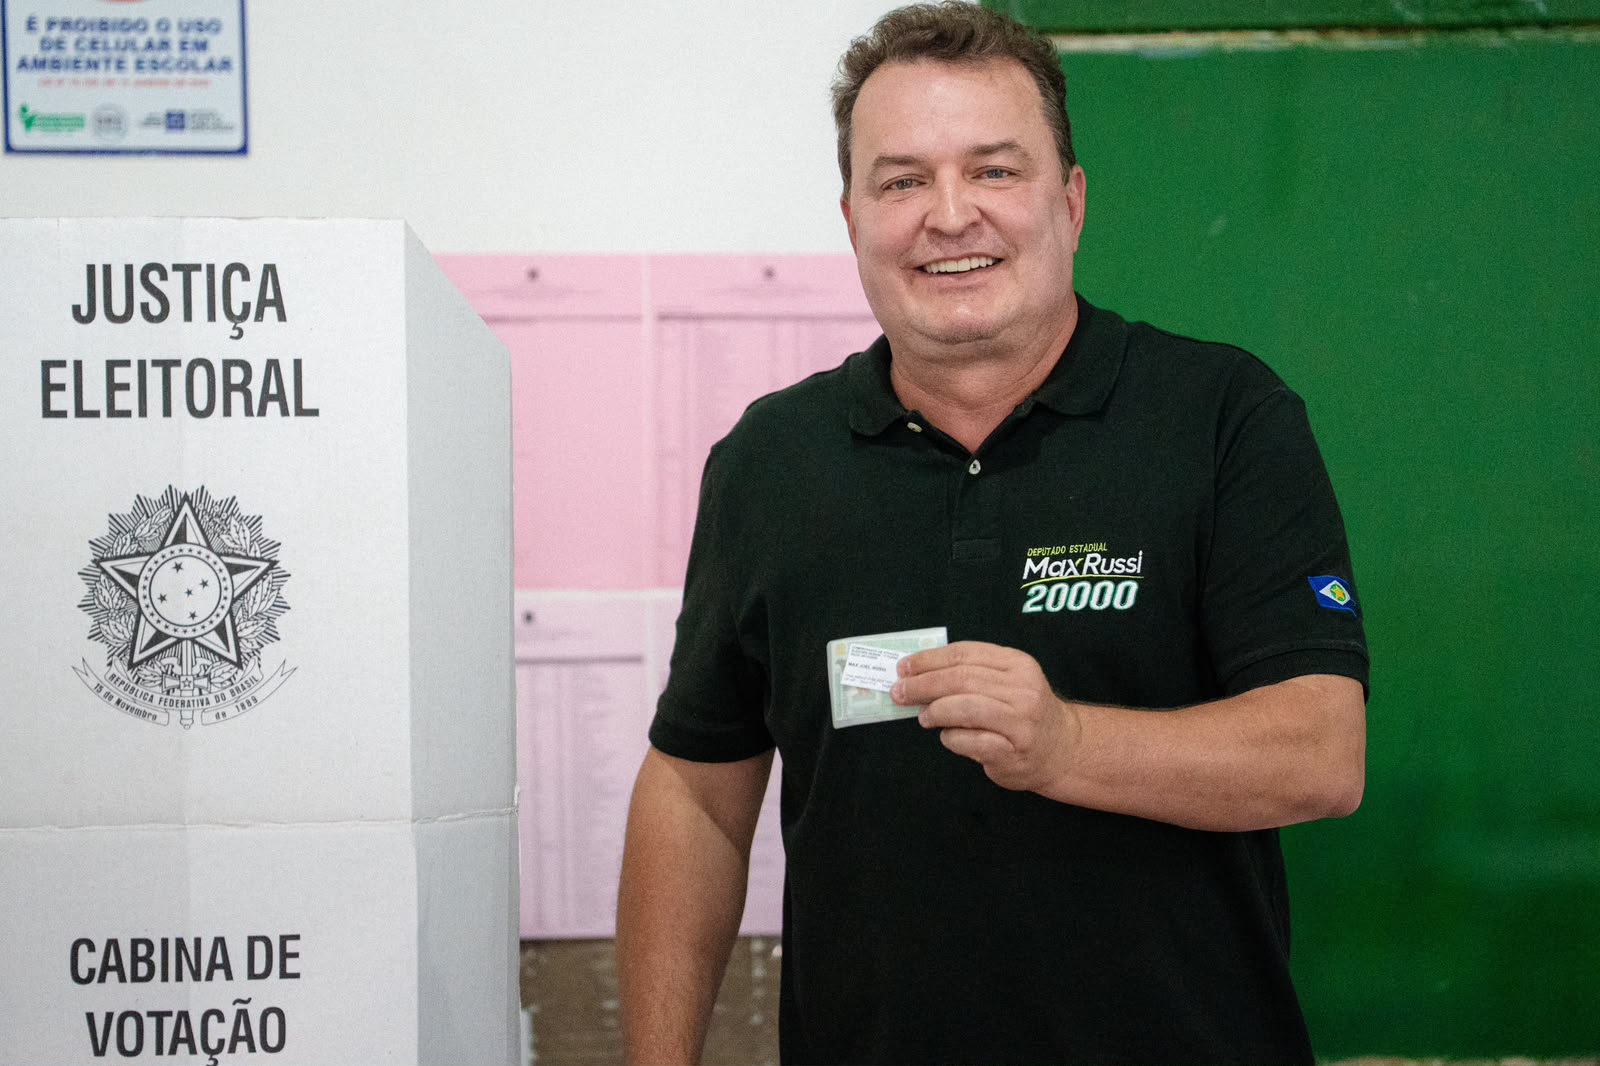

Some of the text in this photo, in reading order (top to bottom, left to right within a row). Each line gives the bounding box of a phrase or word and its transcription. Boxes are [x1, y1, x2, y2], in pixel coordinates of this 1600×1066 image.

[46, 17, 148, 33] PROIBIDO
[156, 18, 171, 33] O
[178, 18, 222, 34] USO
[40, 38, 208, 52] DE CELULAR EM
[17, 57, 233, 72] AMBIENTE ESCOLAR
[71, 262, 287, 340] JUSTIÇA
[40, 357, 320, 418] ELEITORAL
[1027, 542, 1108, 557] DEPUTADO ESTADUAL
[1022, 580, 1139, 613] 20000
[94, 683, 258, 721] 15 de Novembro de 1889
[158, 696, 210, 708] FEDERATIVA
[214, 693, 226, 703] DO
[229, 675, 259, 697] BRASIL
[70, 934, 301, 986] CABINA DE
[86, 997, 287, 1066] VOTAÇÃO
